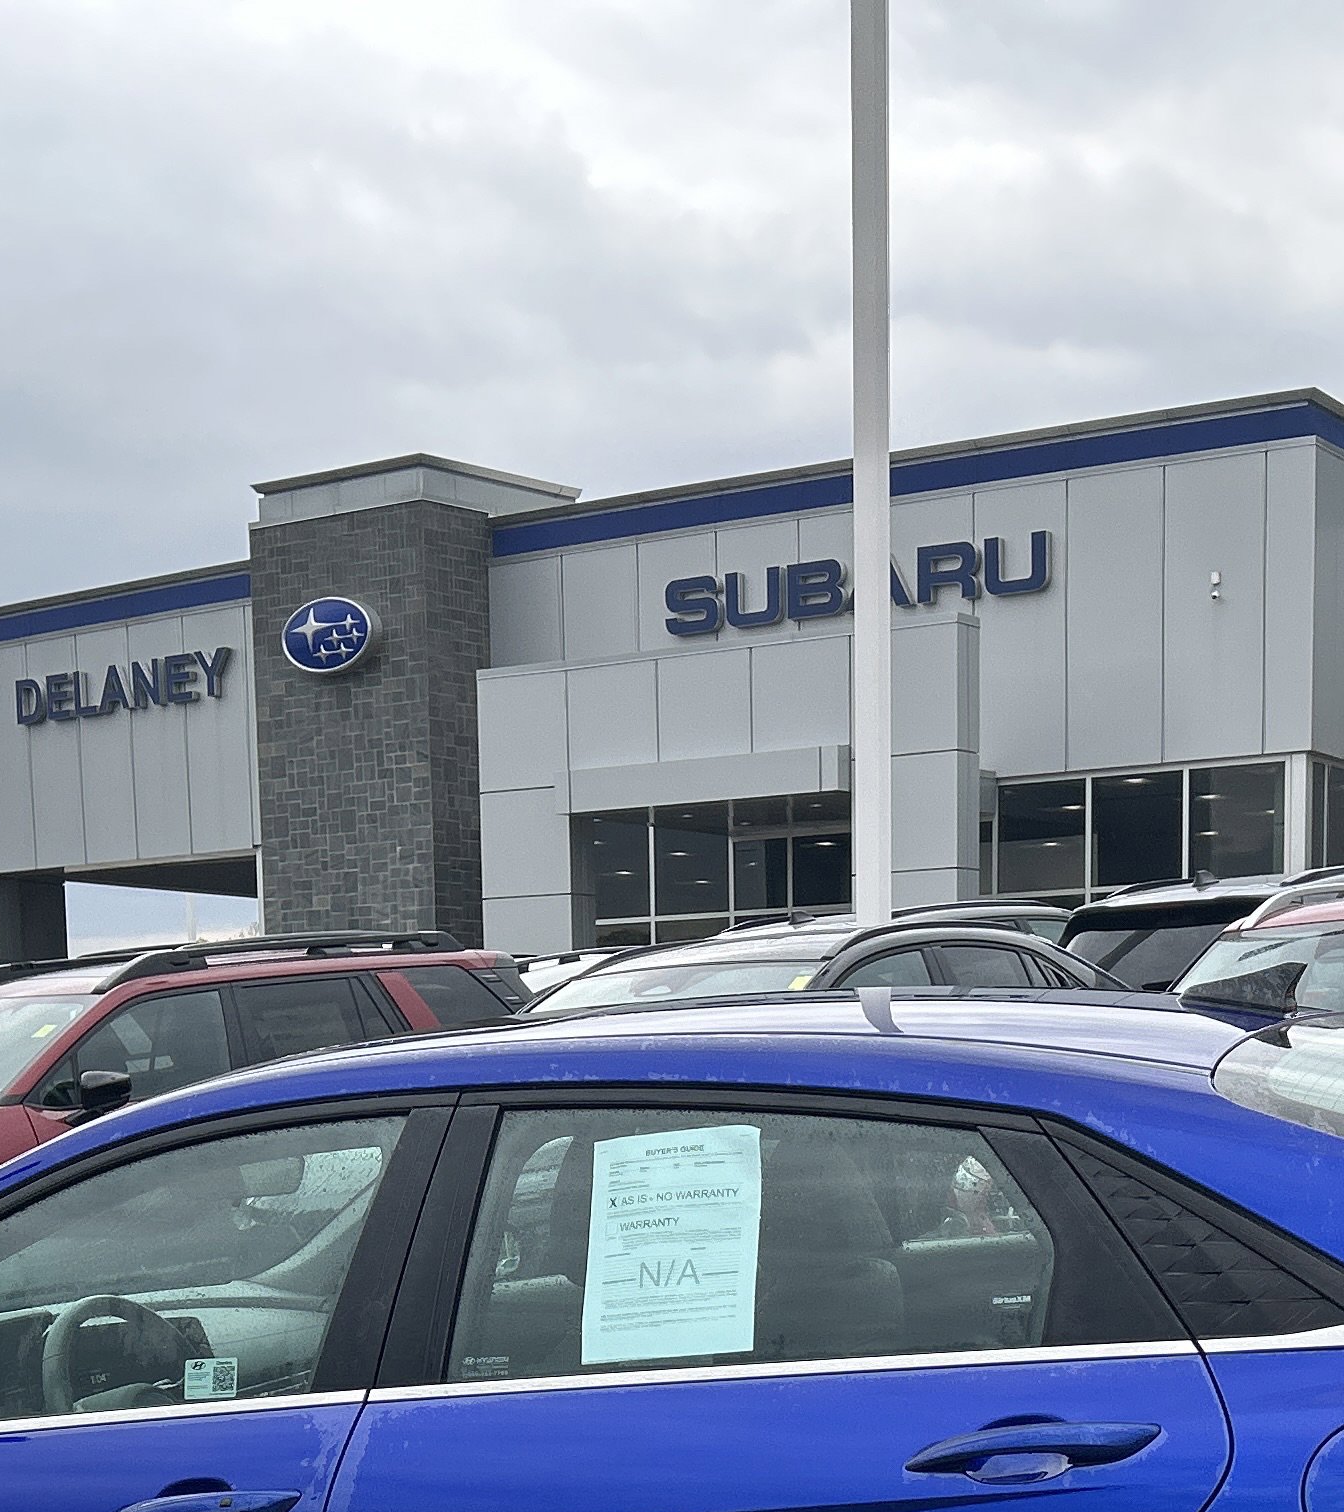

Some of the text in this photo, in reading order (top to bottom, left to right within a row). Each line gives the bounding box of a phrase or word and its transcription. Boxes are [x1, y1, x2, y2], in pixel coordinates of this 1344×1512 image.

[15, 647, 232, 726] DELANEY
[620, 1195, 635, 1206] AS
[637, 1193, 648, 1205] IS
[656, 1191, 673, 1202] NO
[675, 1187, 739, 1200] WARRANTY
[619, 1217, 680, 1232] WARRANTY
[639, 1258, 701, 1289] N/A
